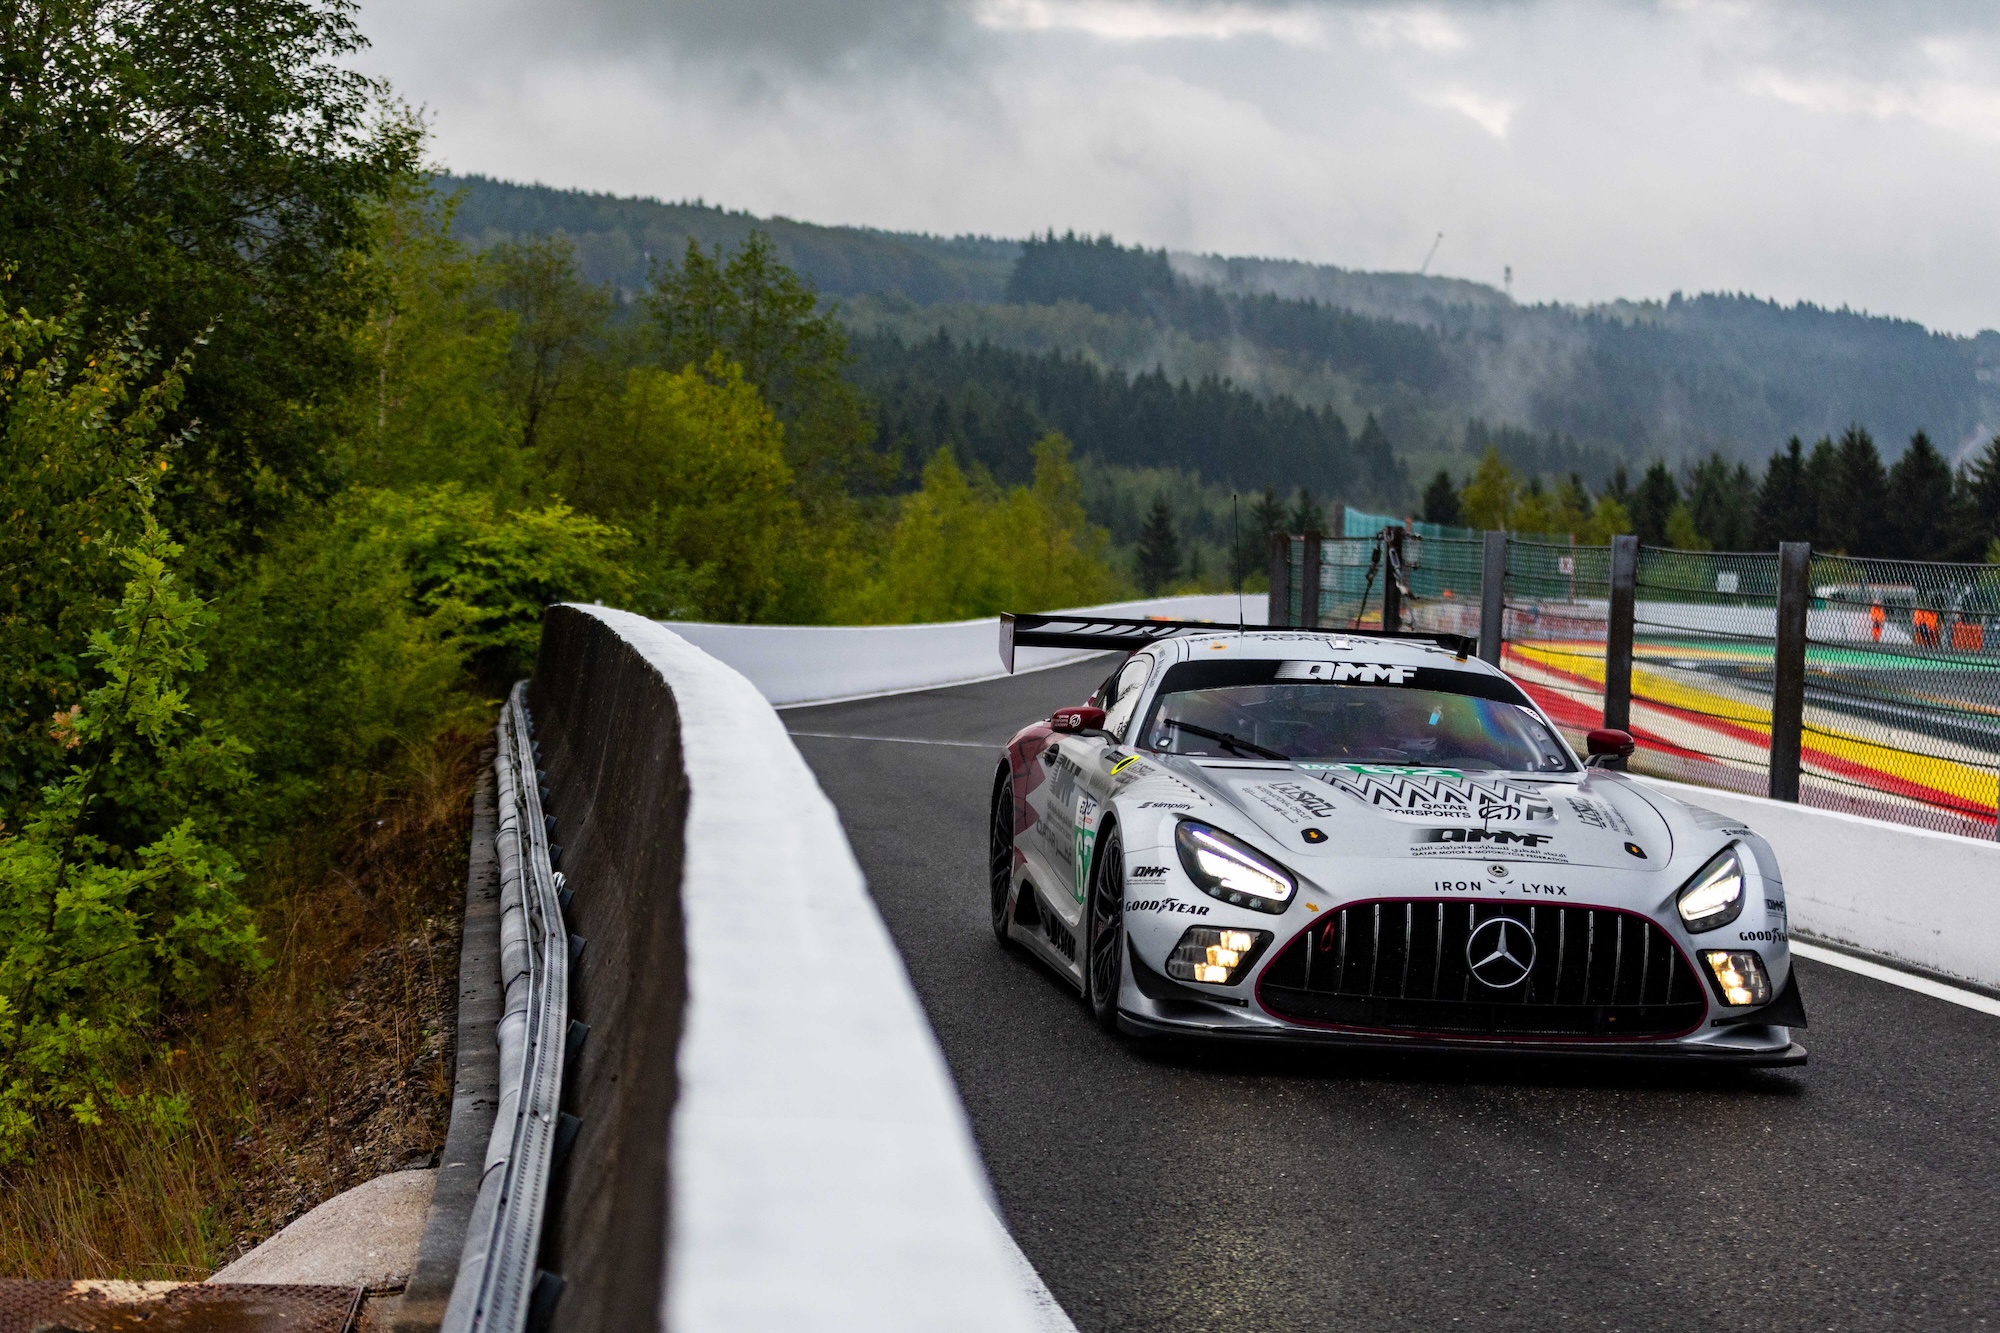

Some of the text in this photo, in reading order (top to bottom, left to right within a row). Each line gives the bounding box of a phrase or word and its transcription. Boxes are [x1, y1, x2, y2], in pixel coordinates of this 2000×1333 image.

[1286, 661, 1417, 684] QMMF
[1151, 801, 1194, 811] simplify
[1421, 803, 1468, 811] QATAR
[1424, 828, 1553, 847] QMMF
[1434, 881, 1567, 896] IRON LYNX
